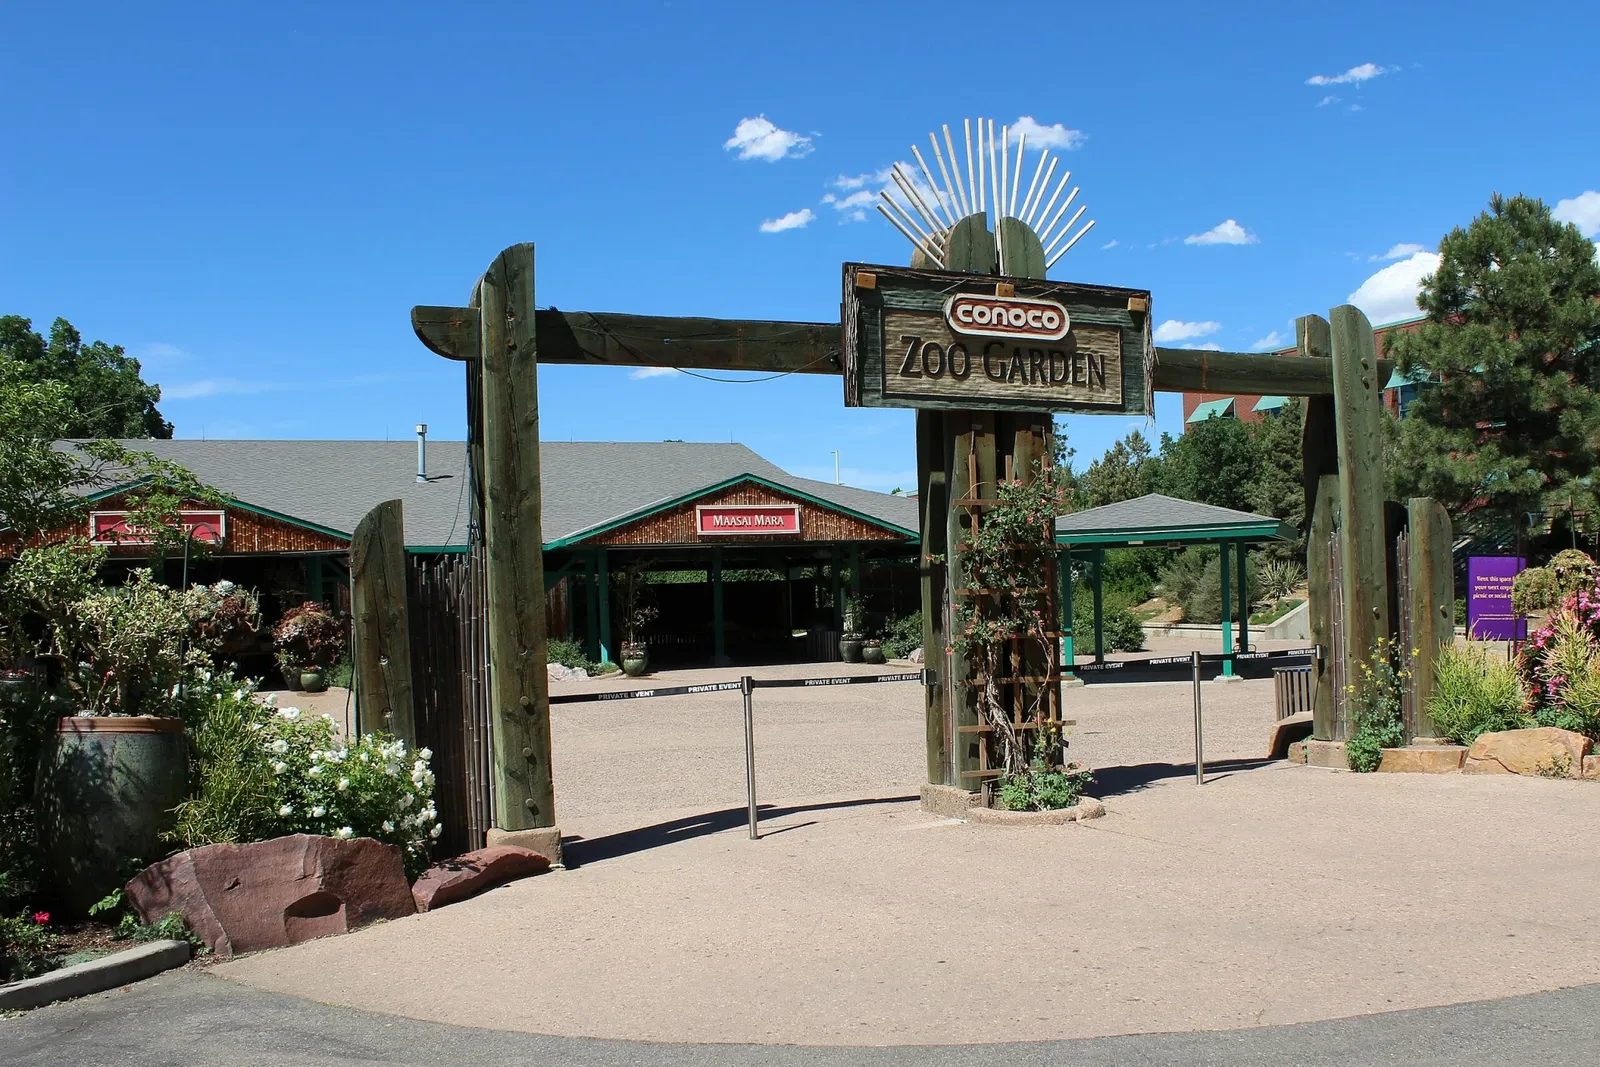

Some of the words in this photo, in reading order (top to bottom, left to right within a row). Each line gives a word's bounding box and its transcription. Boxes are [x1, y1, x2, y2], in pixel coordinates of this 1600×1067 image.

[900, 335, 972, 382] ZOO
[983, 341, 1106, 391] GARDEN
[713, 514, 752, 526] MAASAI
[754, 514, 784, 526] MARA
[688, 684, 717, 693] PRIVATE
